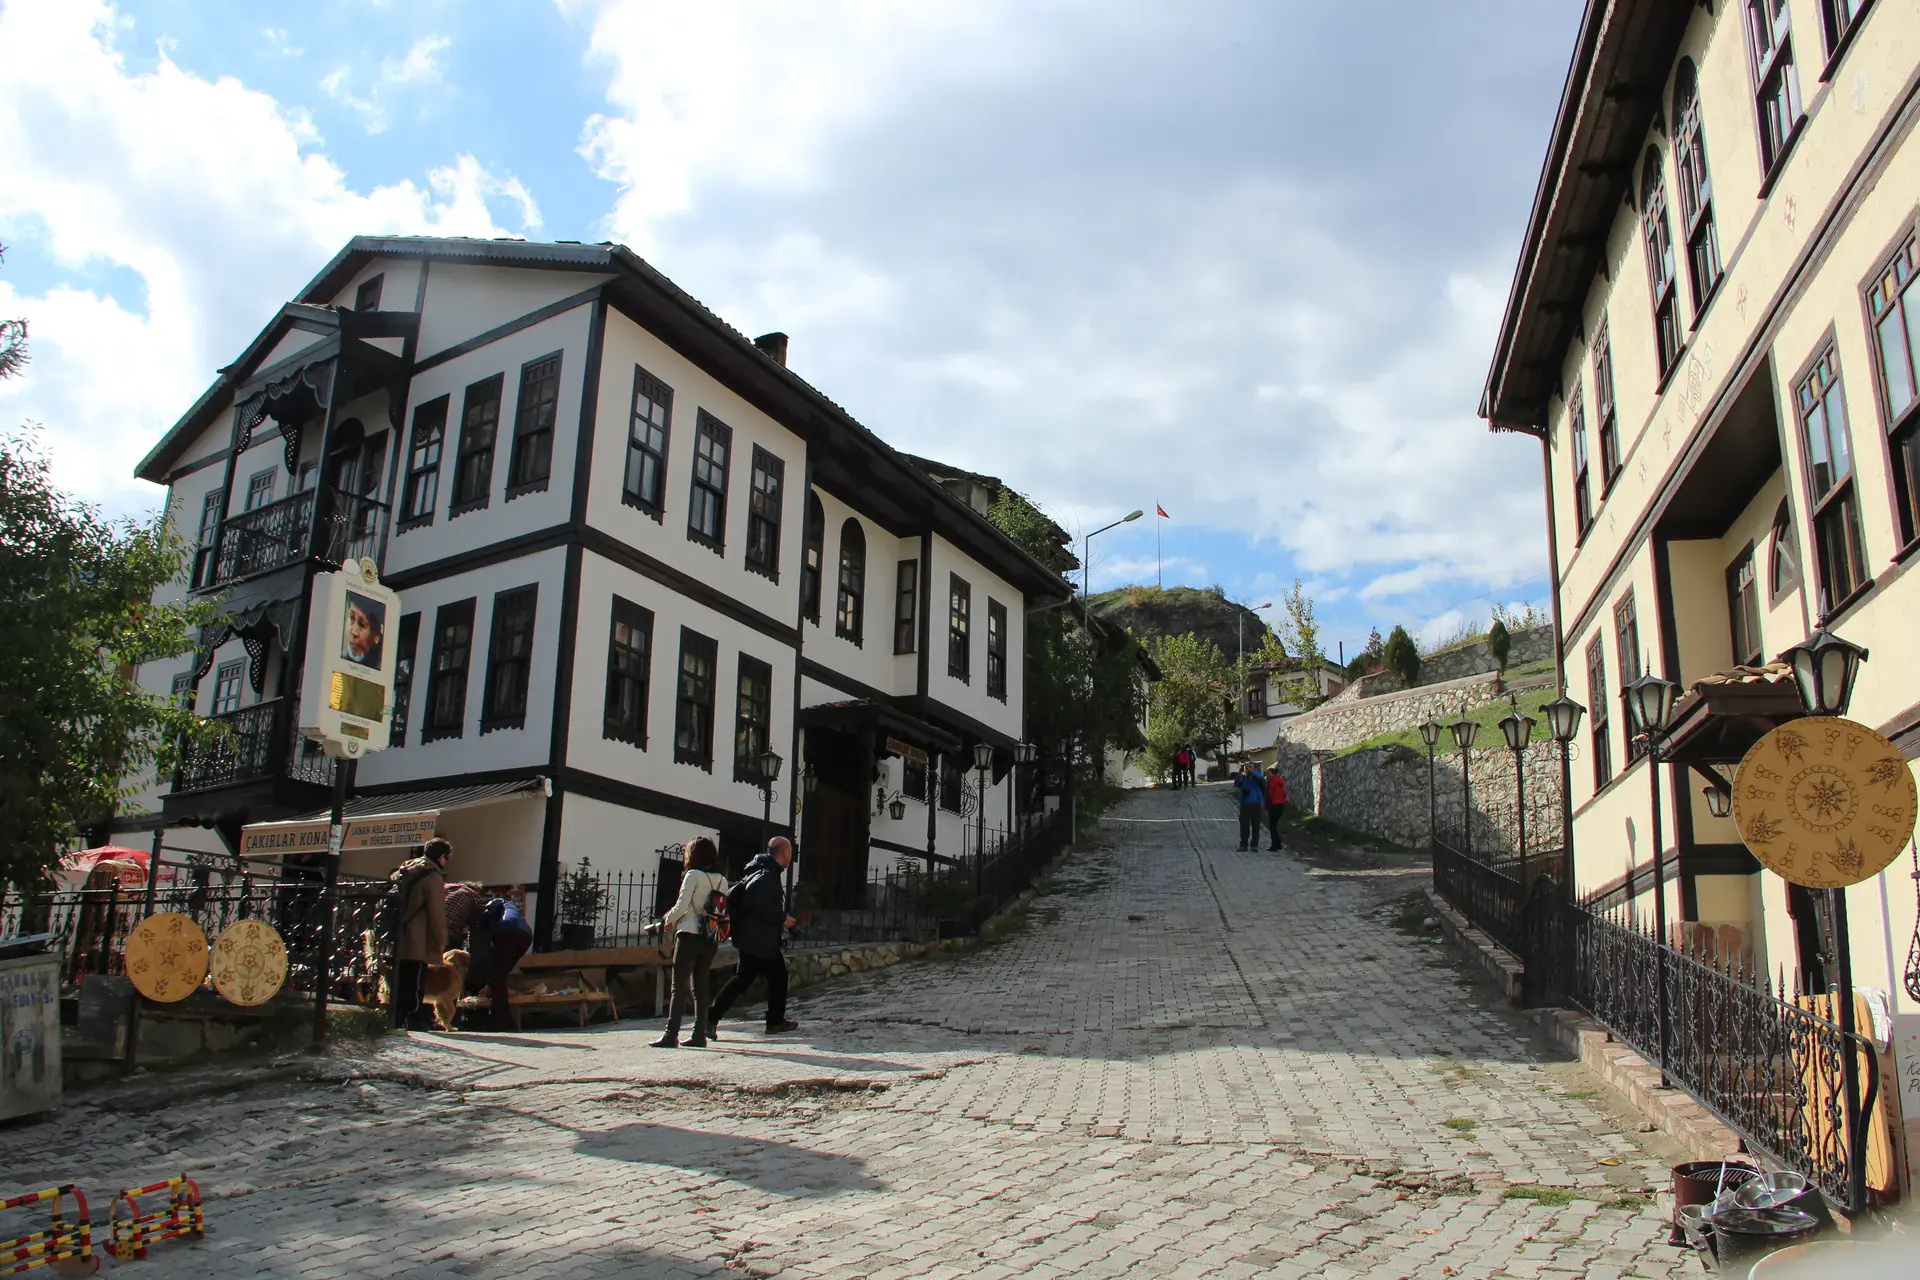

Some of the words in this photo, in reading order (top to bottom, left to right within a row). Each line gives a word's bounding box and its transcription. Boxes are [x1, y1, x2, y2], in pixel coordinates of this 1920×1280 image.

[246, 833, 296, 852] ÇAKIRLAR
[299, 831, 328, 846] KONA
[1906, 1061, 1920, 1076] Ke
[1908, 1078, 1920, 1093] Pe
